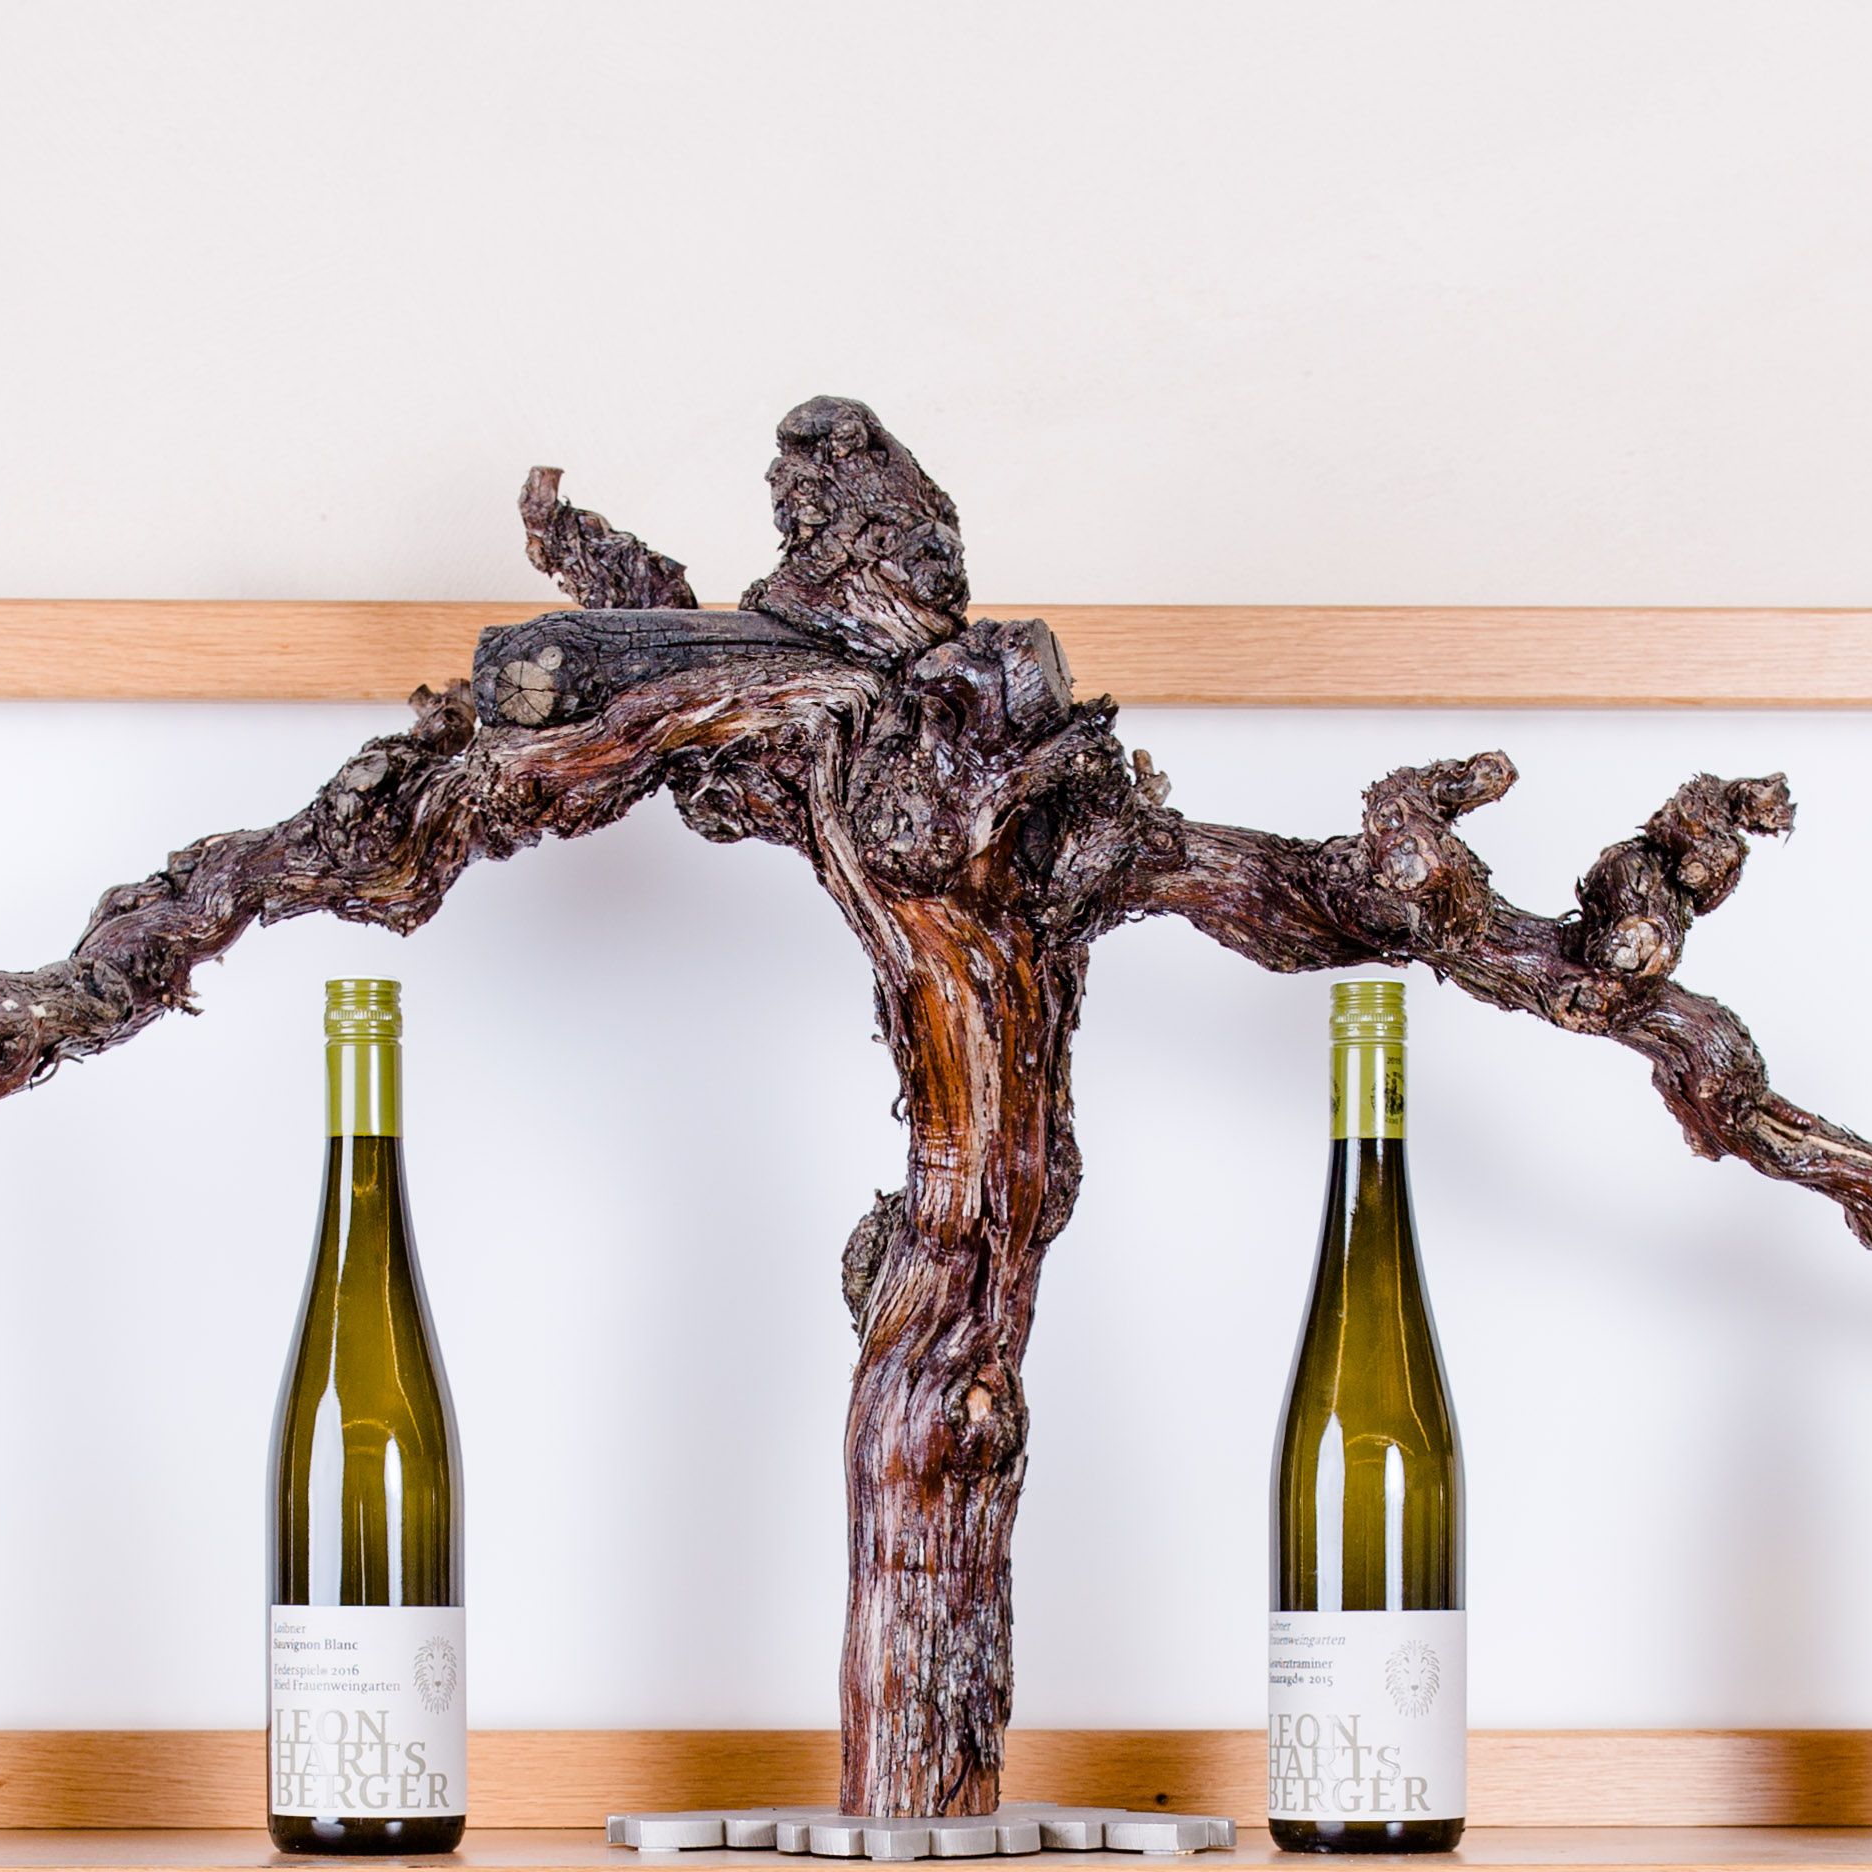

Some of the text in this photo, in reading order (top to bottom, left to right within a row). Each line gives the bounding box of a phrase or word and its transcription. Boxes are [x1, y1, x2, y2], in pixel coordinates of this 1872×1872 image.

[273, 1638, 359, 1653] Sauvignon Blanc
[331, 1664, 360, 1676] 2016
[293, 1679, 401, 1694] Frauenweingarten
[1309, 1676, 1334, 1687] 2015
[275, 1708, 390, 1745] LEON
[276, 1741, 427, 1778] HARTS
[276, 1772, 451, 1809] BERGER
